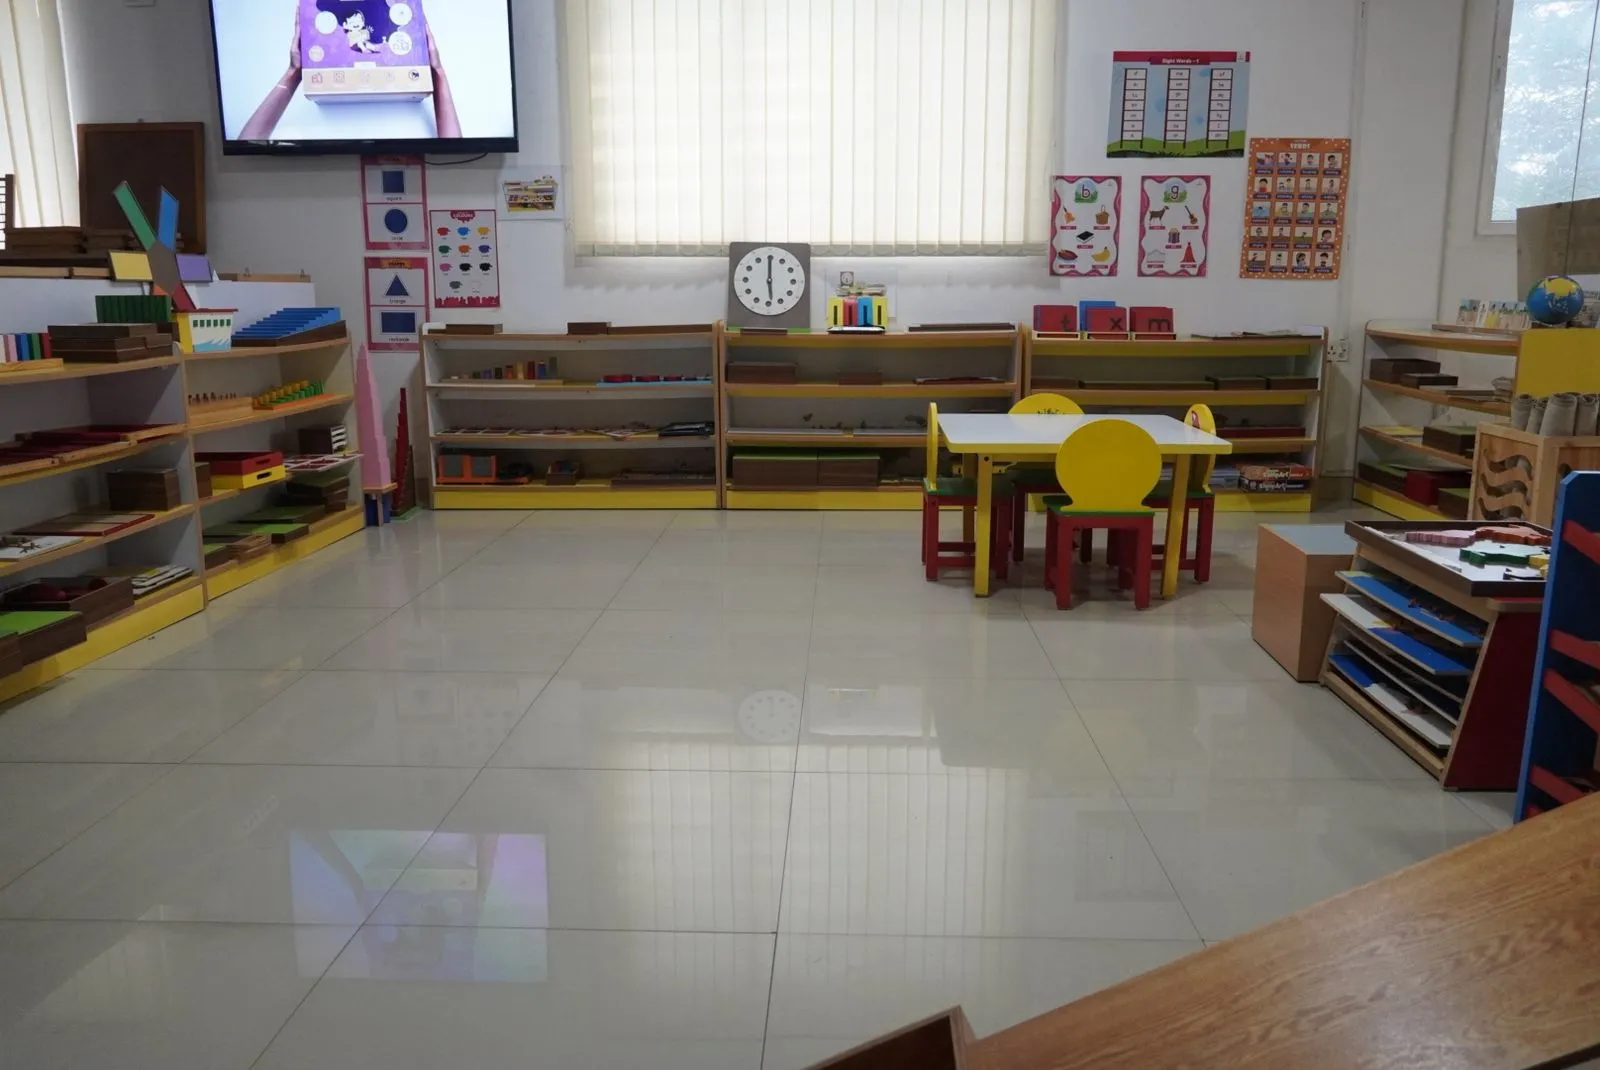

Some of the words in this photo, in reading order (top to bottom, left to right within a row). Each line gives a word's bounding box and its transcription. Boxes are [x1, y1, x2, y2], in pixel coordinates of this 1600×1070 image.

[1081, 184, 1091, 199] b
[1170, 185, 1180, 200] g
[1061, 314, 1073, 332] t
[1109, 316, 1123, 331] x
[1148, 317, 1171, 332] m
